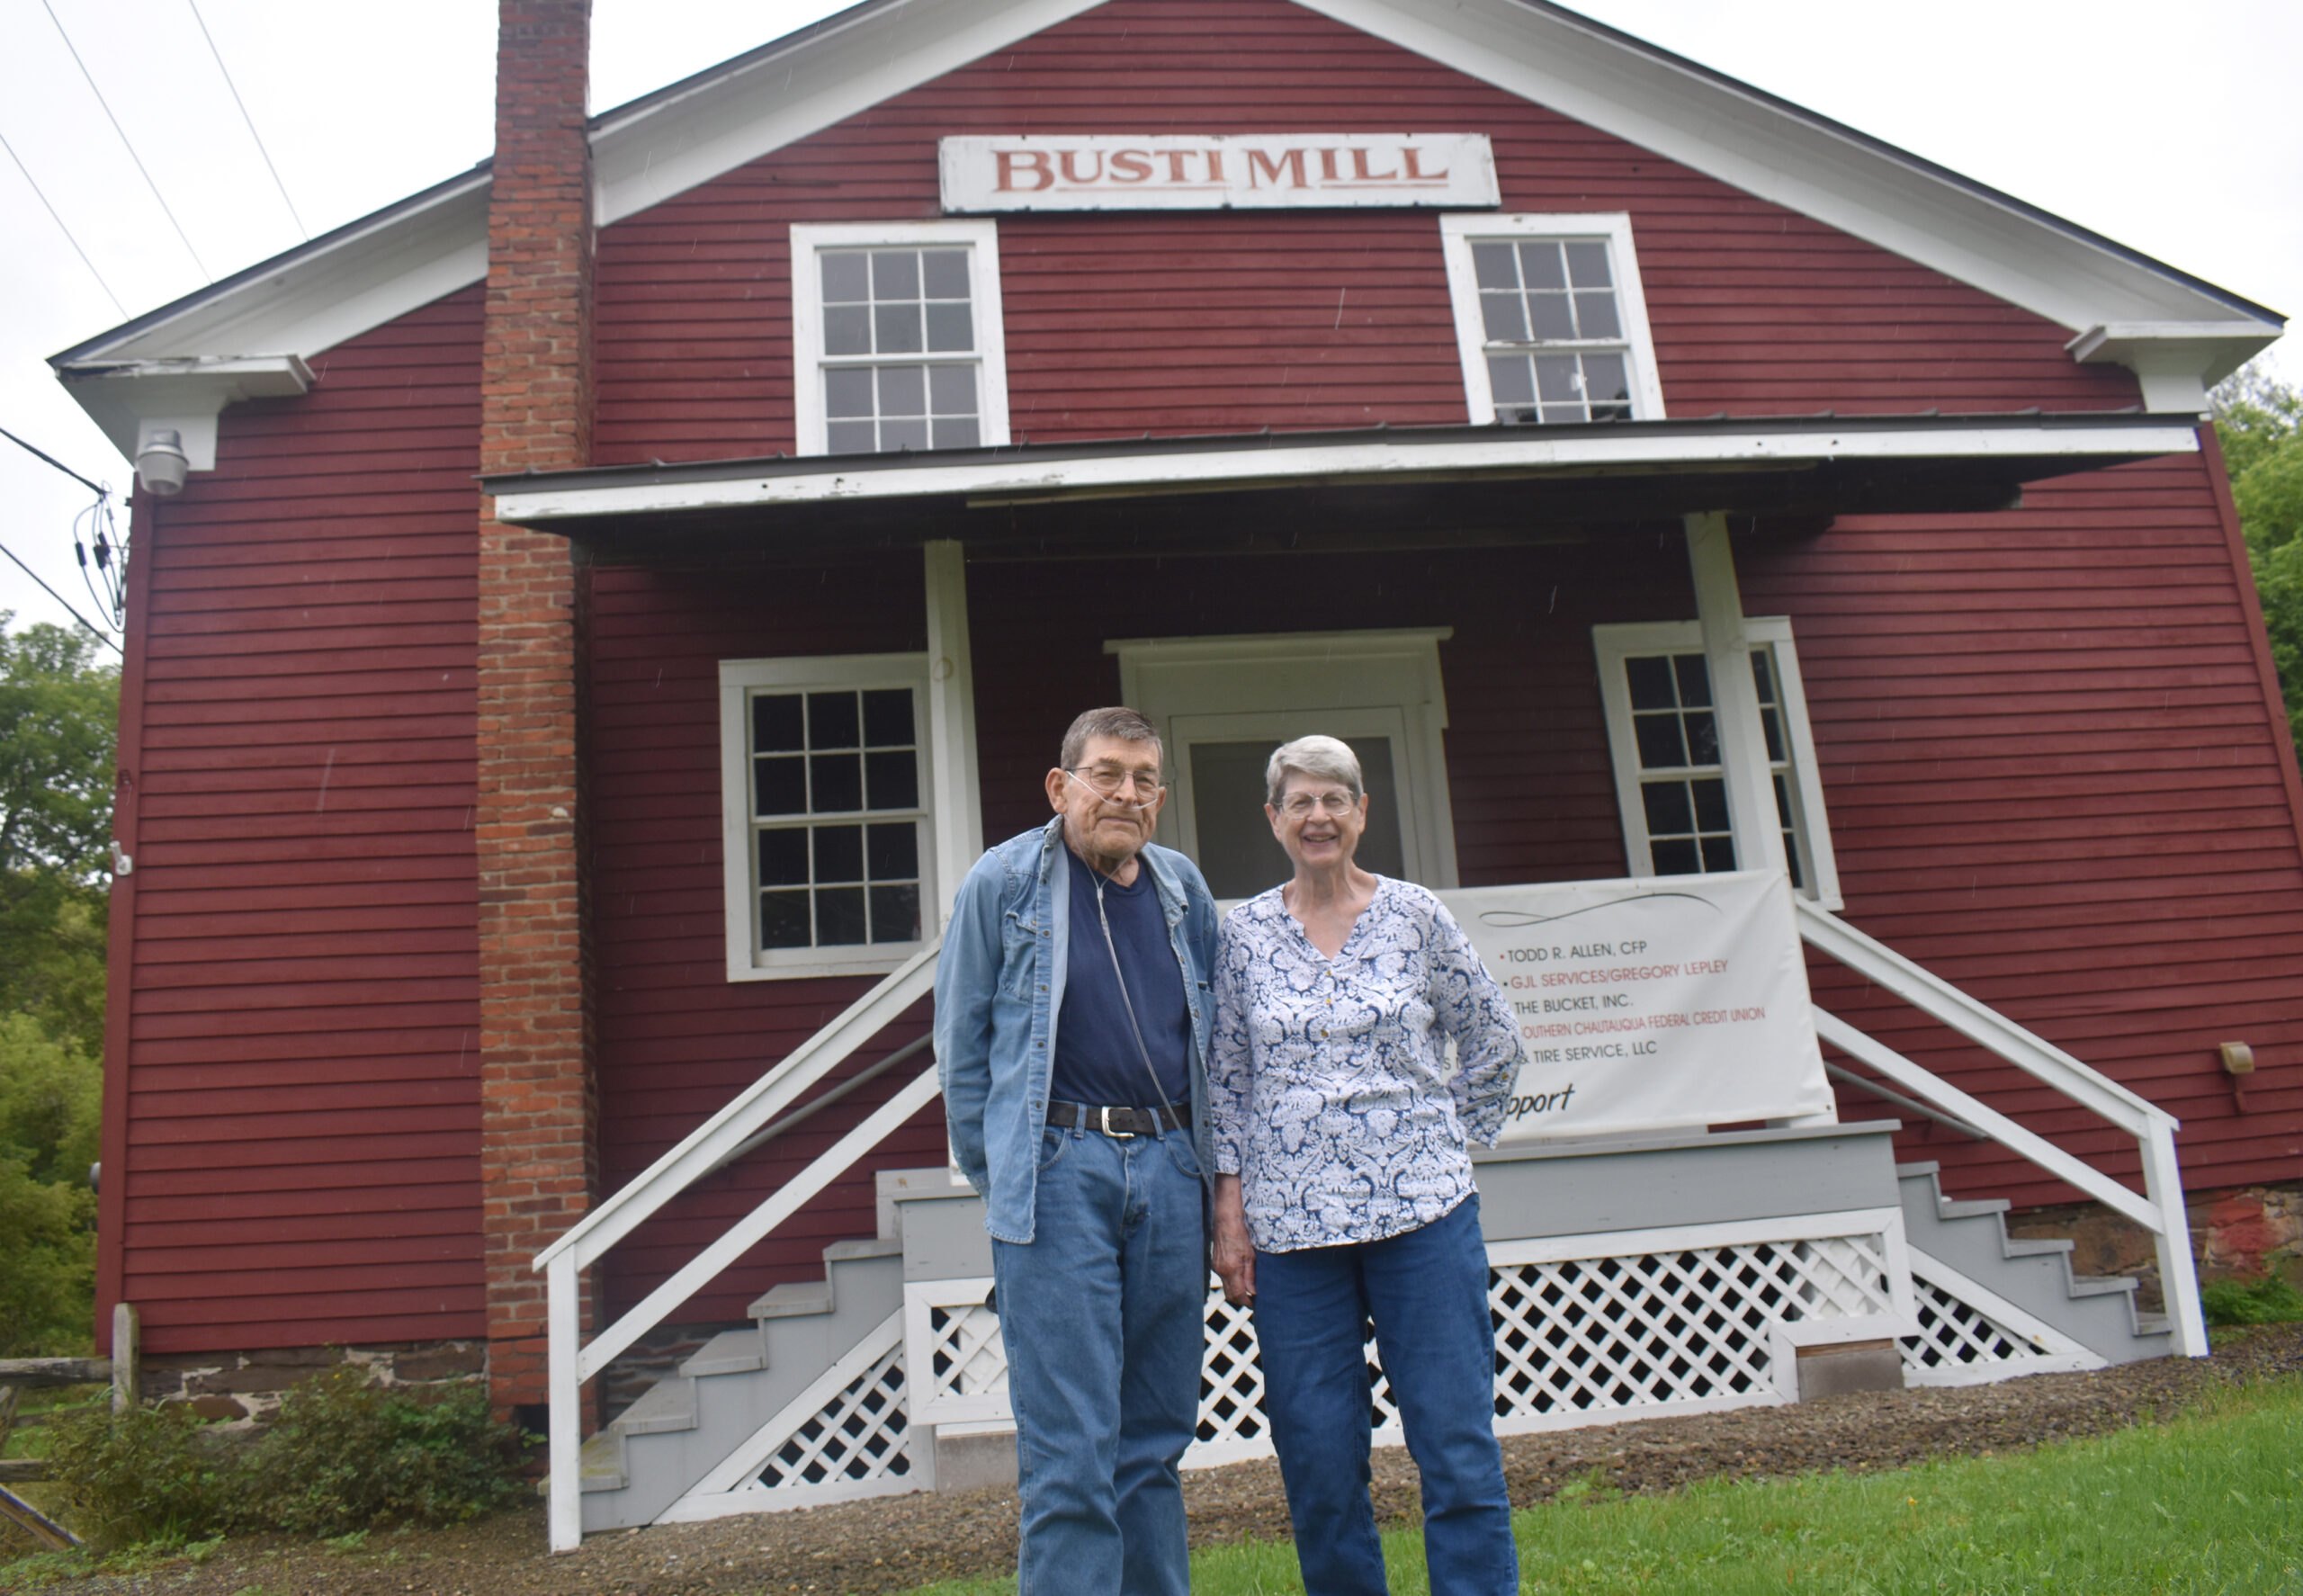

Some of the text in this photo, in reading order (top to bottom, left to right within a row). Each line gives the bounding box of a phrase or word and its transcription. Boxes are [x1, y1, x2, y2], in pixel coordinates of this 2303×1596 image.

[993, 147, 1449, 193] BUSTI MILL
[1508, 940, 1647, 963] TODD R. ALLEN, CFP
[1510, 959, 1729, 990] GJL SERVICES/GREGORY LEPLEY
[1515, 993, 1634, 1015] THE BUCKET, INC.
[1520, 1007, 1766, 1039] OUTHERN CHAUTAUQUA FEDERAL CREDIT UNION
[1533, 1048, 1561, 1063] TIRE
[1565, 1043, 1628, 1061] SERVICE,
[1633, 1040, 1657, 1055] LLC
[1507, 1082, 1575, 1122] pport
